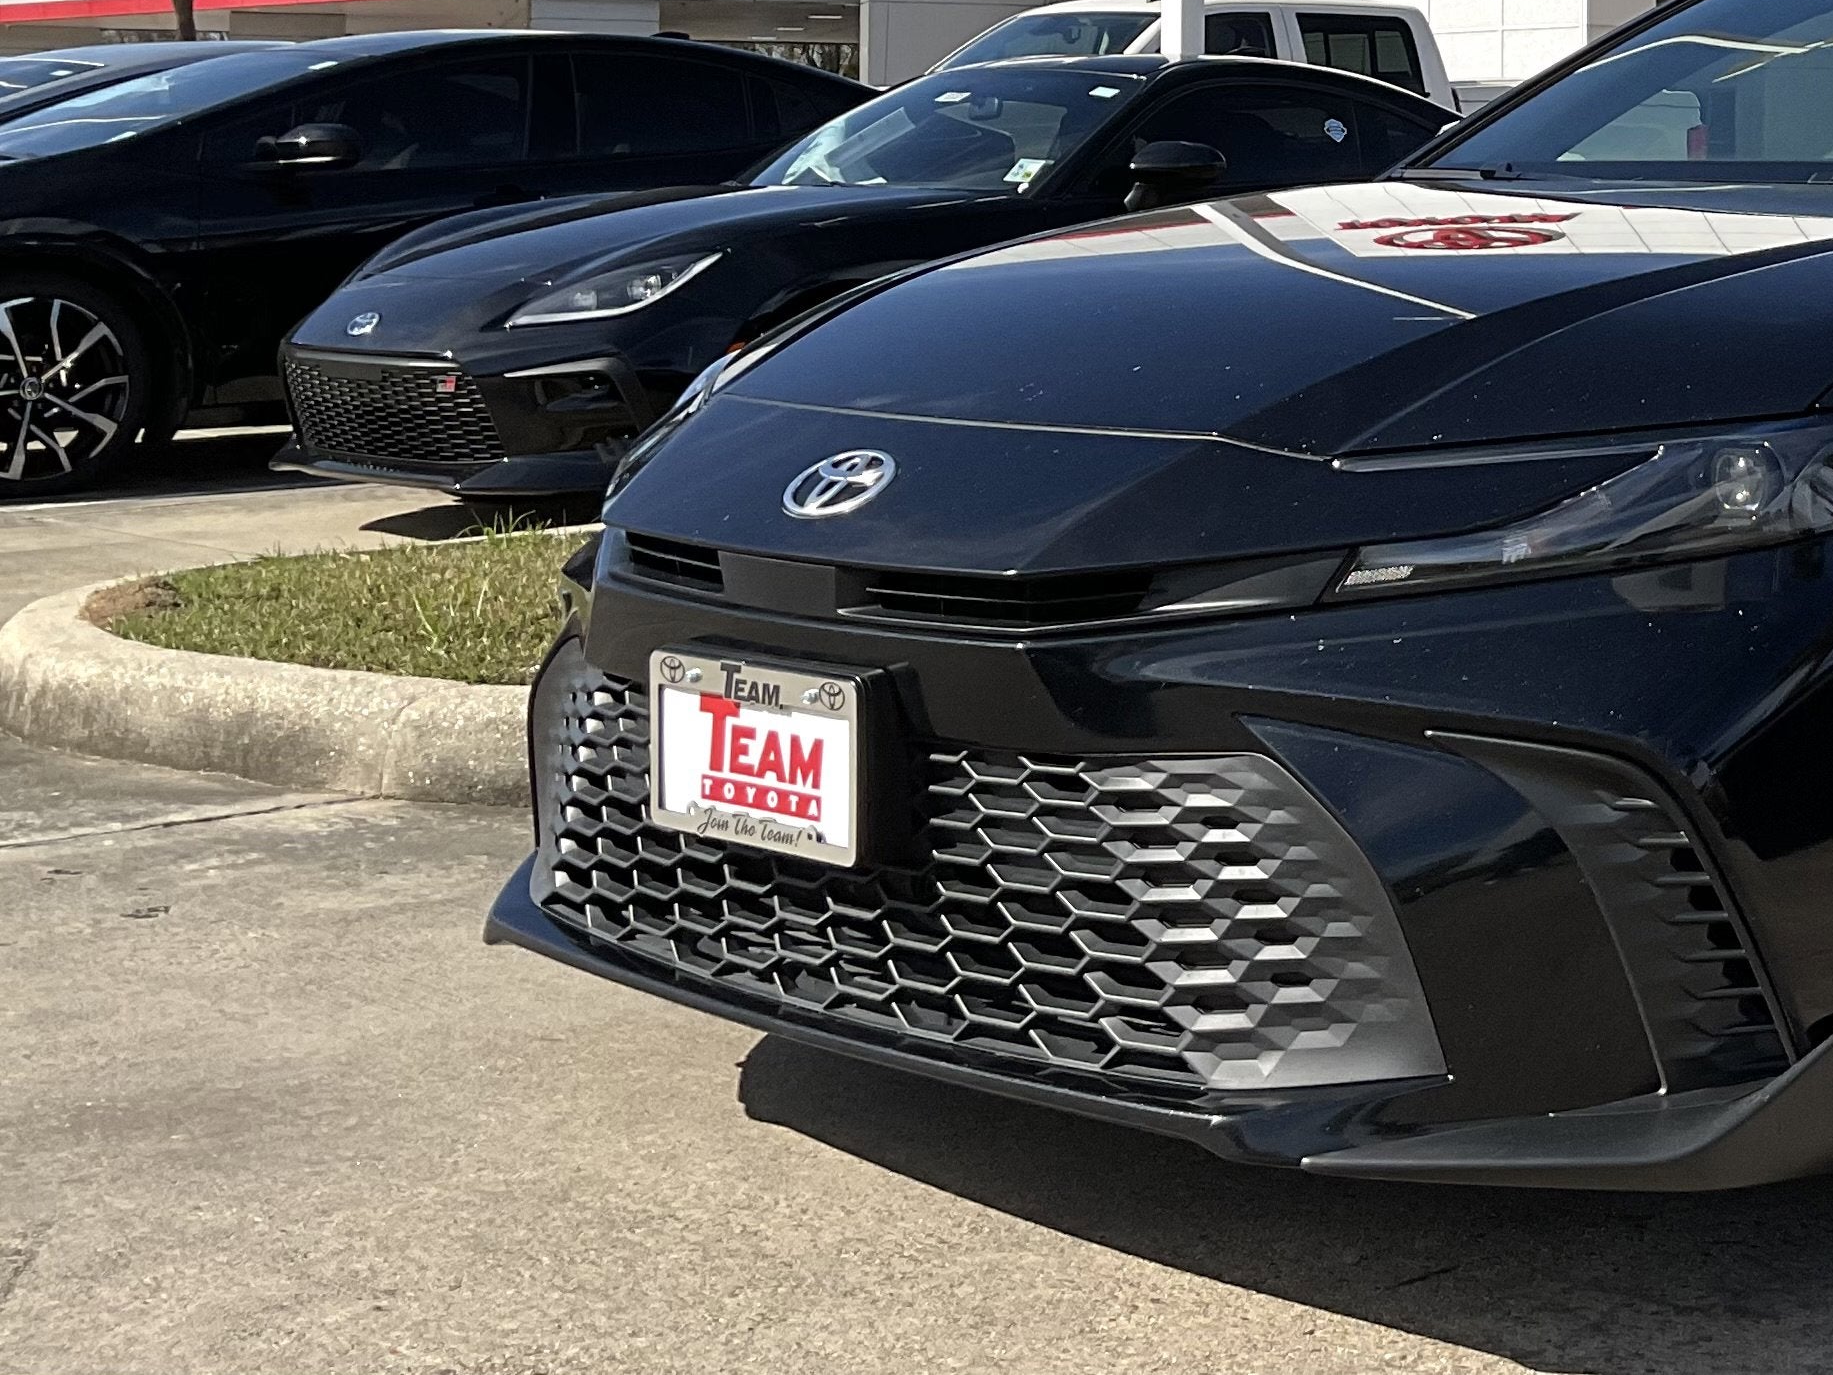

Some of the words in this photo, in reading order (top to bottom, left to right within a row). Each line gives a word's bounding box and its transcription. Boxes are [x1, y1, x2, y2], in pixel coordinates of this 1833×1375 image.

[699, 691, 824, 790] TEAM
[703, 778, 820, 818] TOYOTA
[696, 808, 730, 836] Join
[731, 812, 756, 837] The
[760, 819, 803, 847] Team!
